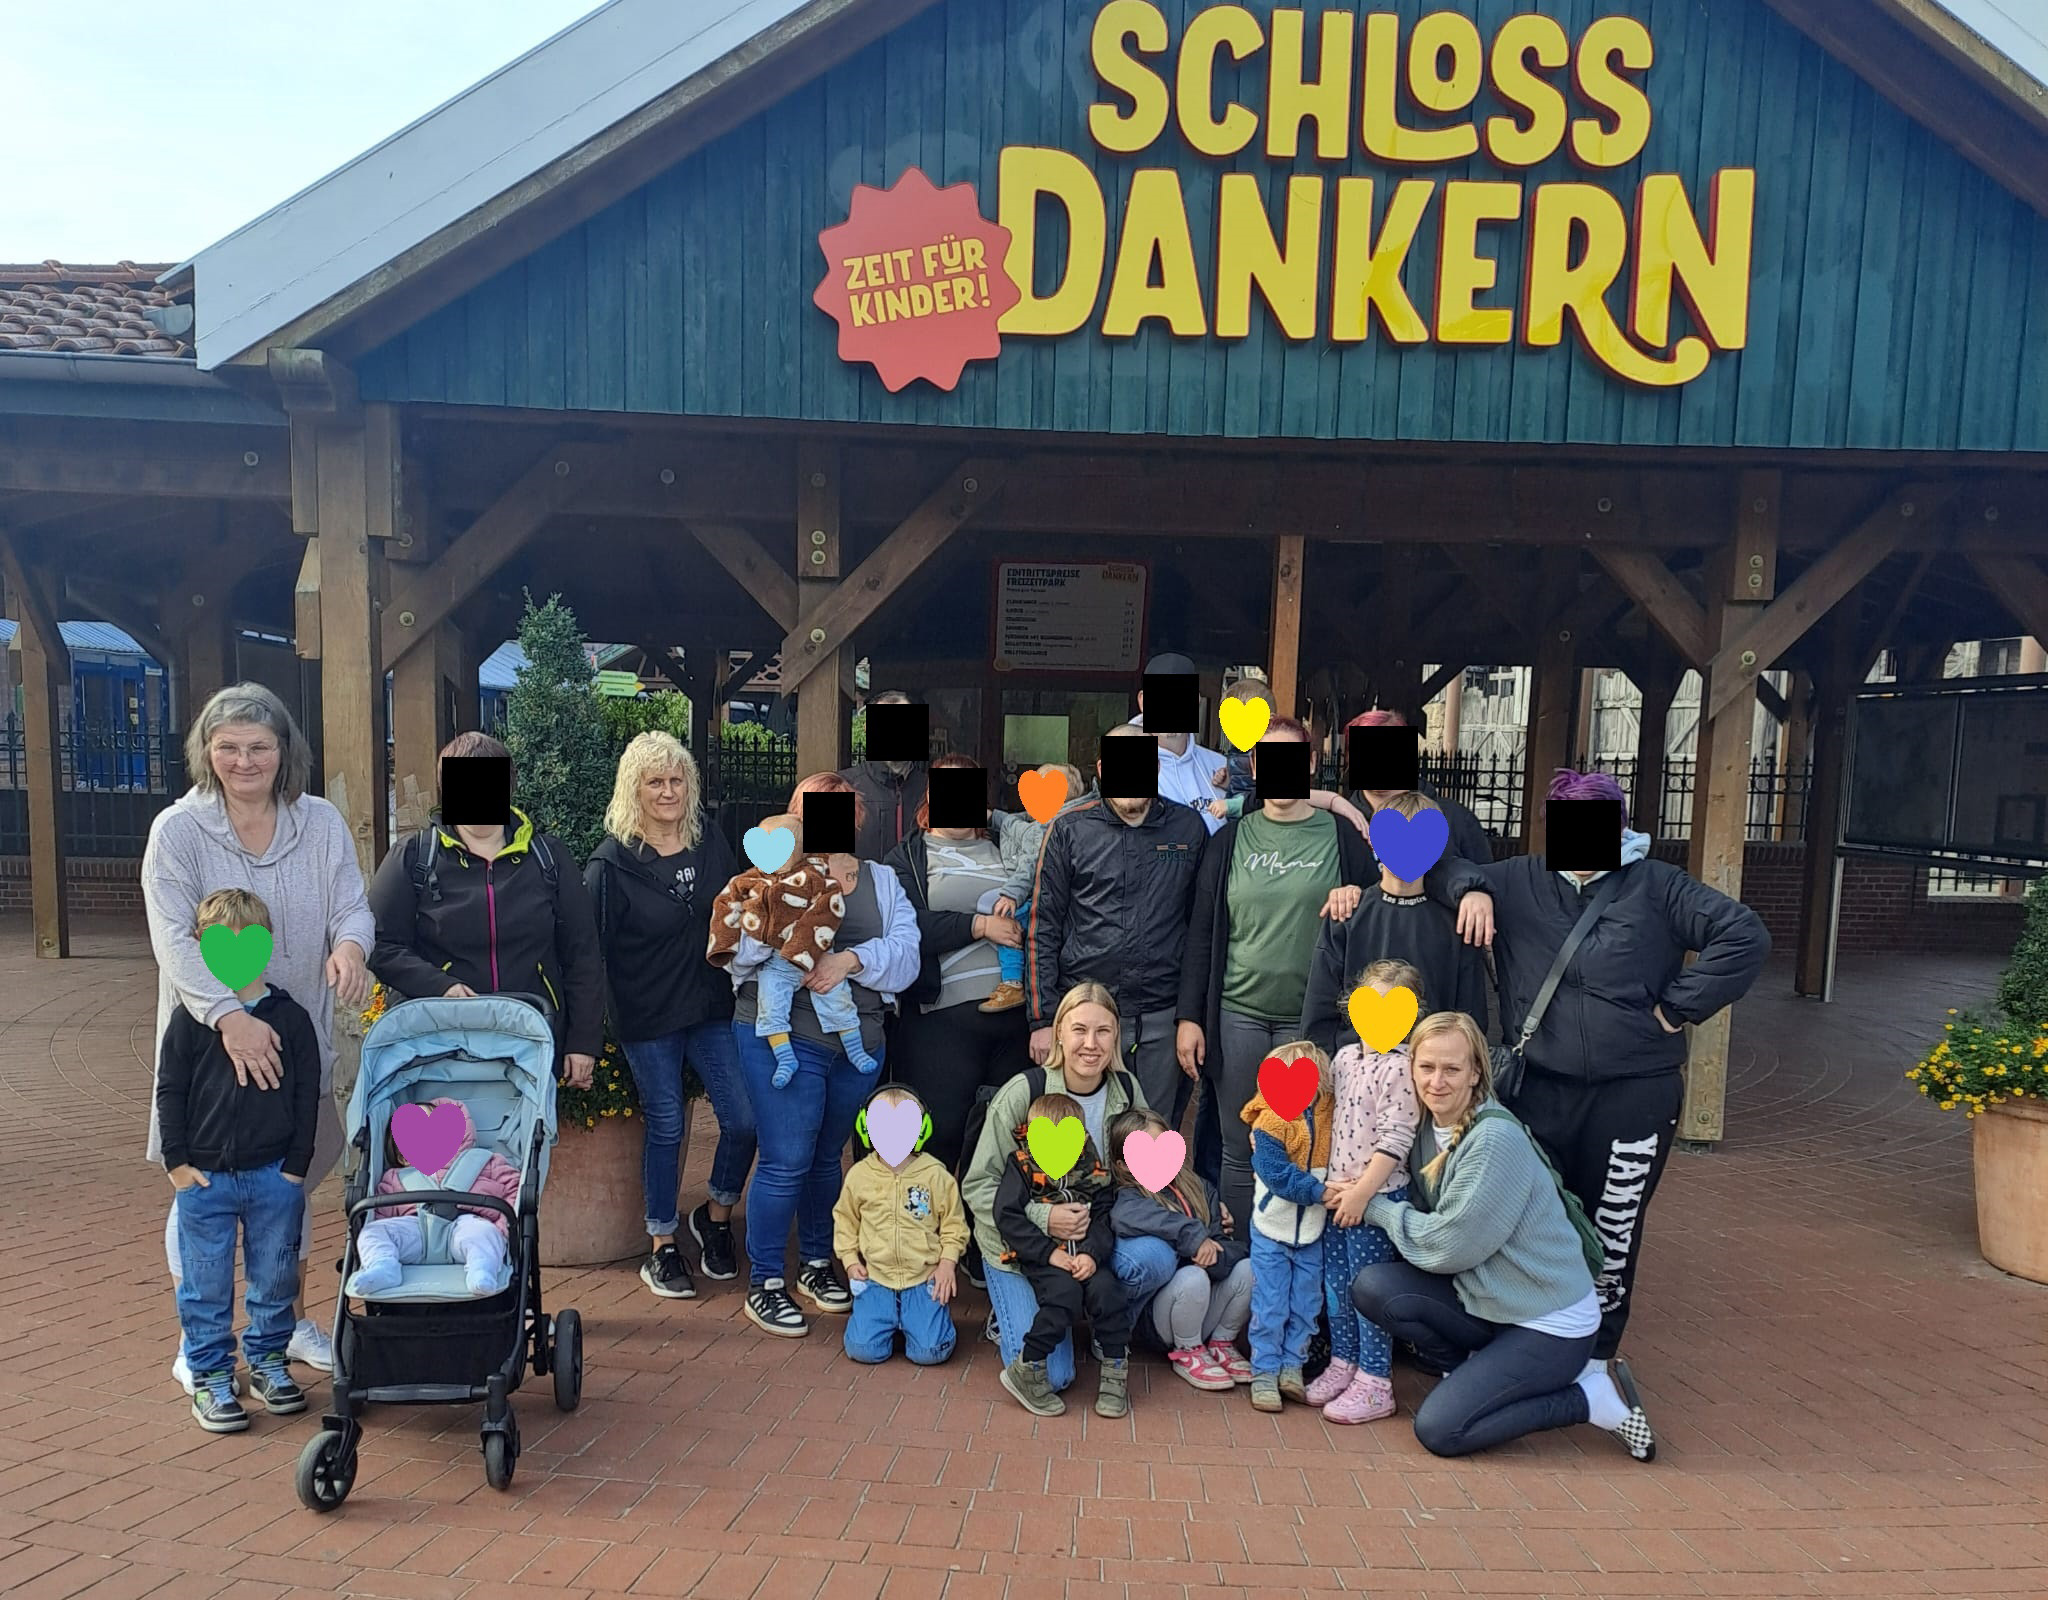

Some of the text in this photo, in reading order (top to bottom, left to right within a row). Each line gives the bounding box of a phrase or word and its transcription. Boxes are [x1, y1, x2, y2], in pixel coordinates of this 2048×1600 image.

[1089, 0, 1654, 168] SCHLOSS
[843, 234, 988, 290] ZEIT FÜR
[998, 146, 1756, 387] DANKERN
[850, 273, 991, 327] KINDER!
[1006, 577, 1066, 586] FREIZEITPARK
[1007, 568, 1080, 578] EINTRITTSPREISE
[1244, 851, 1324, 875] Mama
